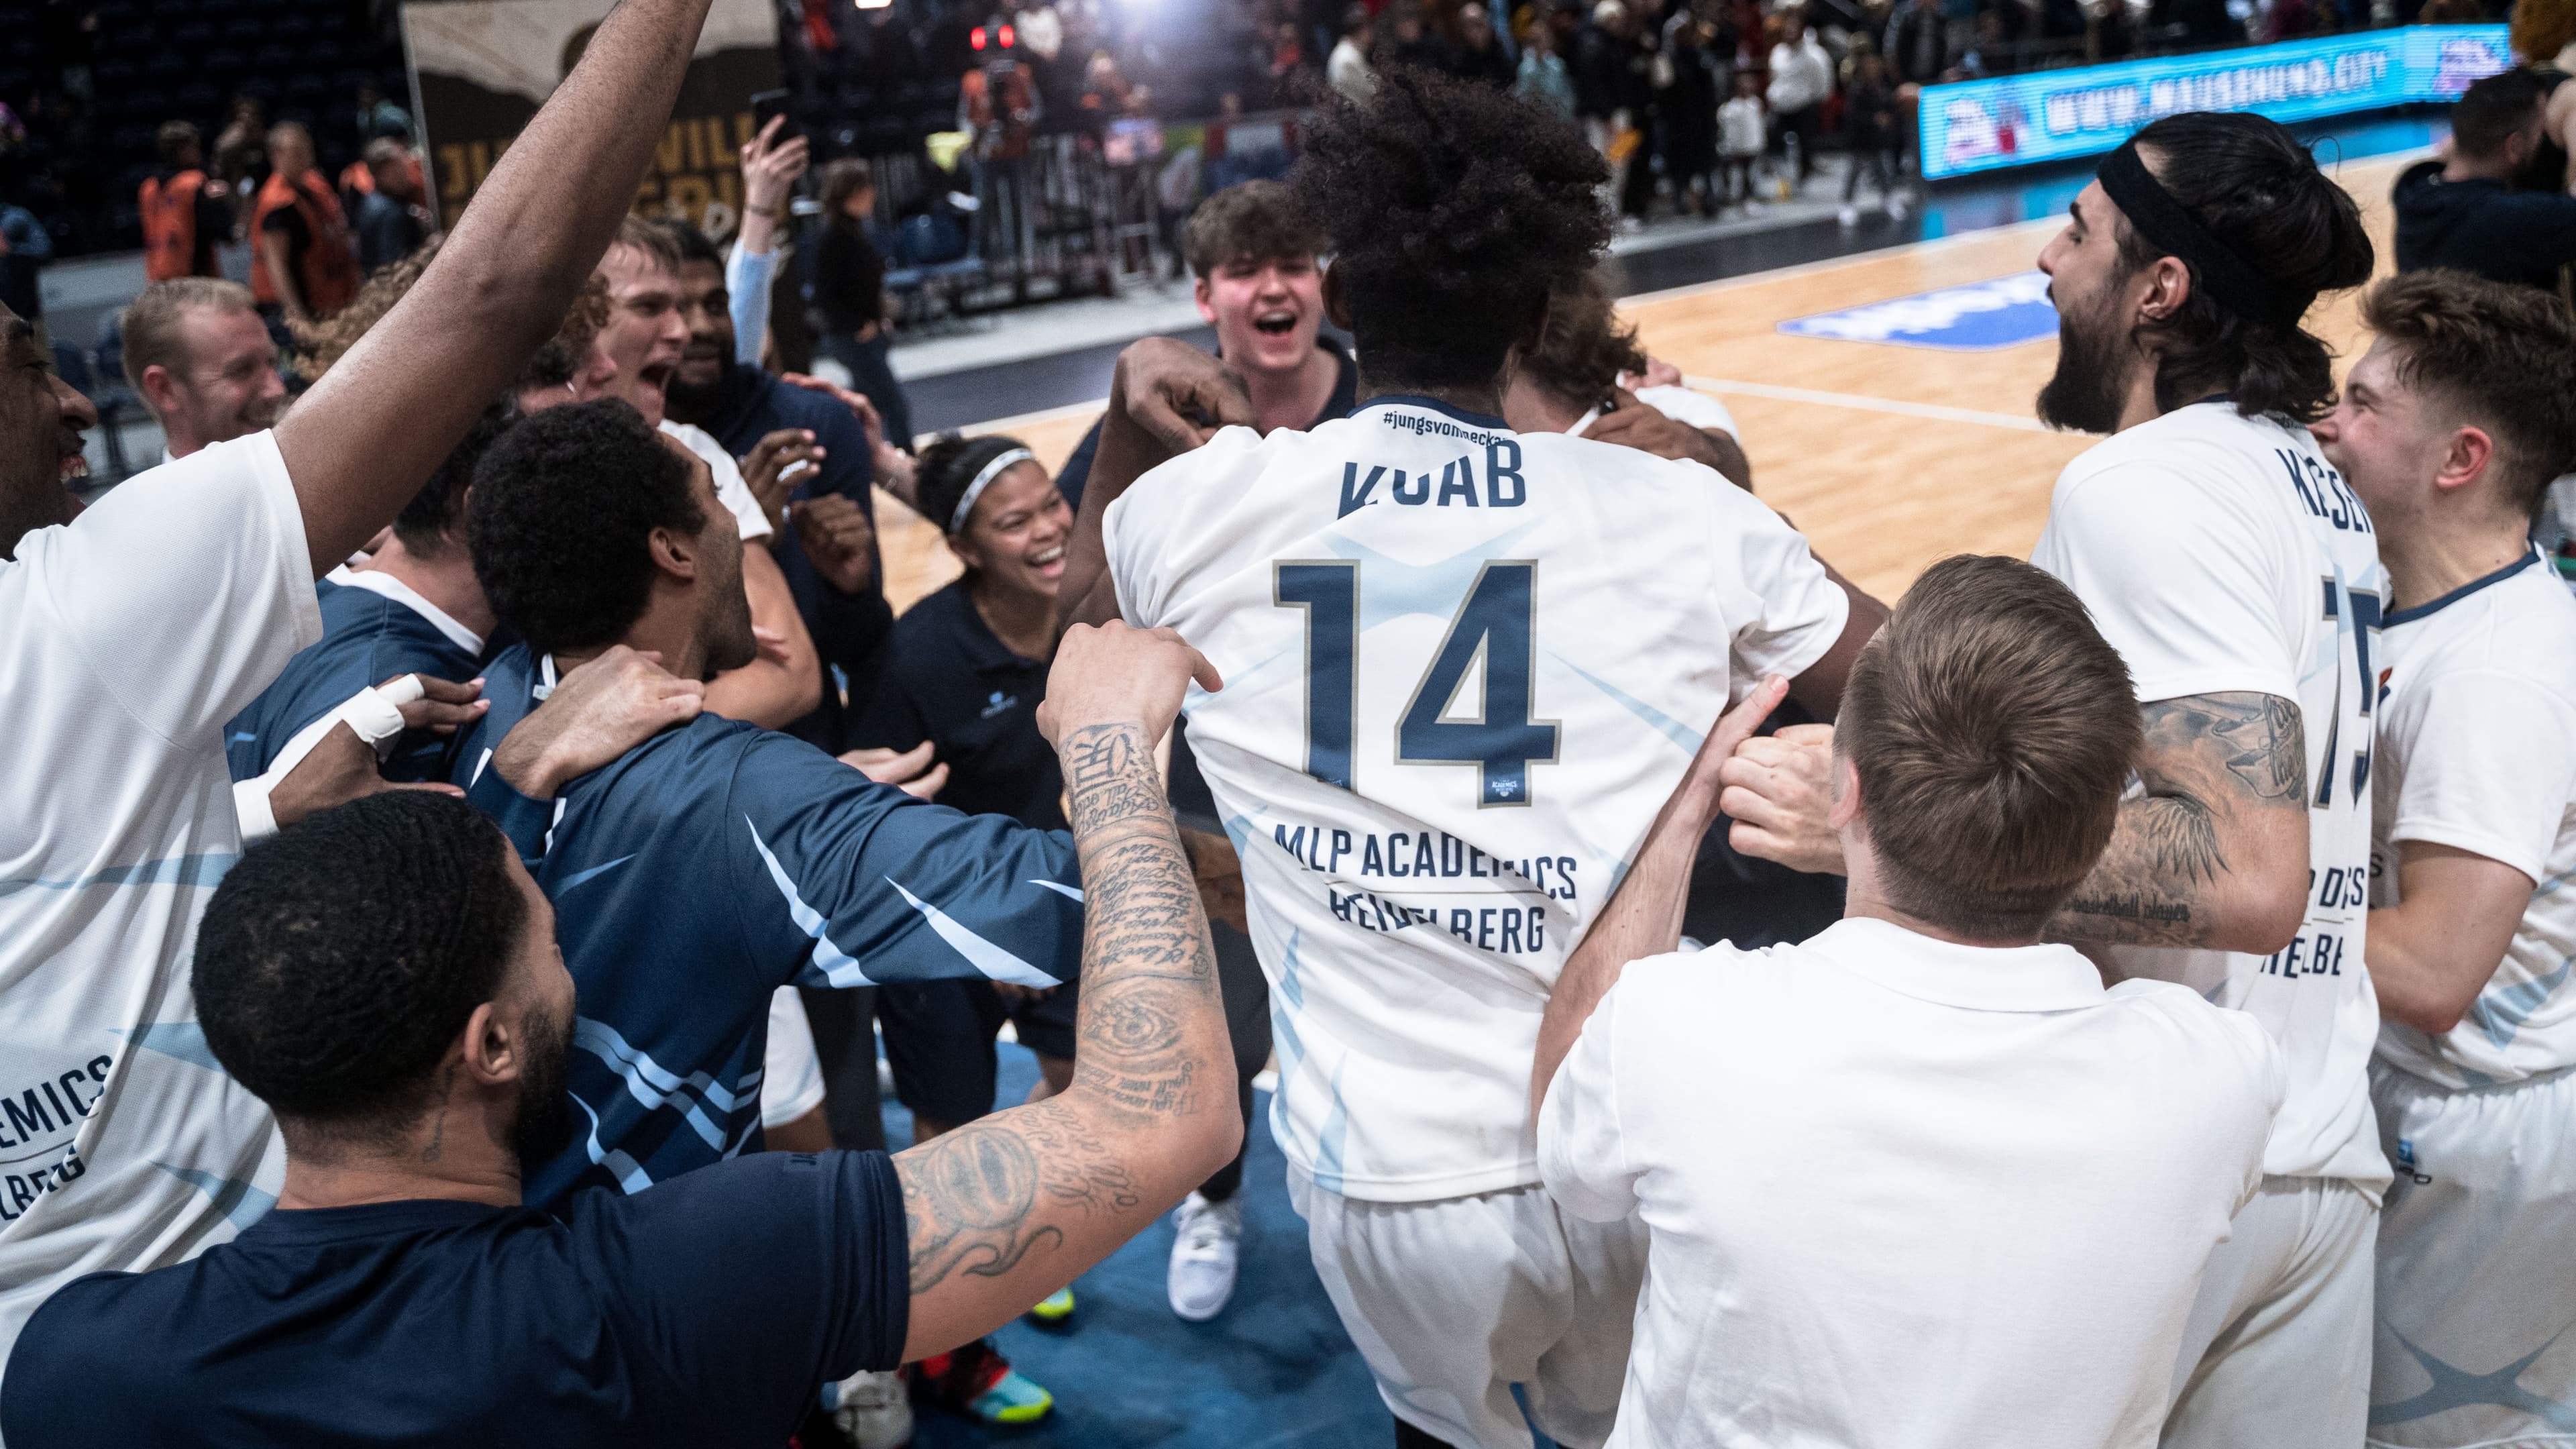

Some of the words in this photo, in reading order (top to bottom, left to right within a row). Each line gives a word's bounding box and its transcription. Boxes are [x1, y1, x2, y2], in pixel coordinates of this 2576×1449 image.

[1383, 411, 1508, 447] #jungsvomnecka
[1273, 559, 1562, 810] 14
[1275, 824, 1352, 873] MLP
